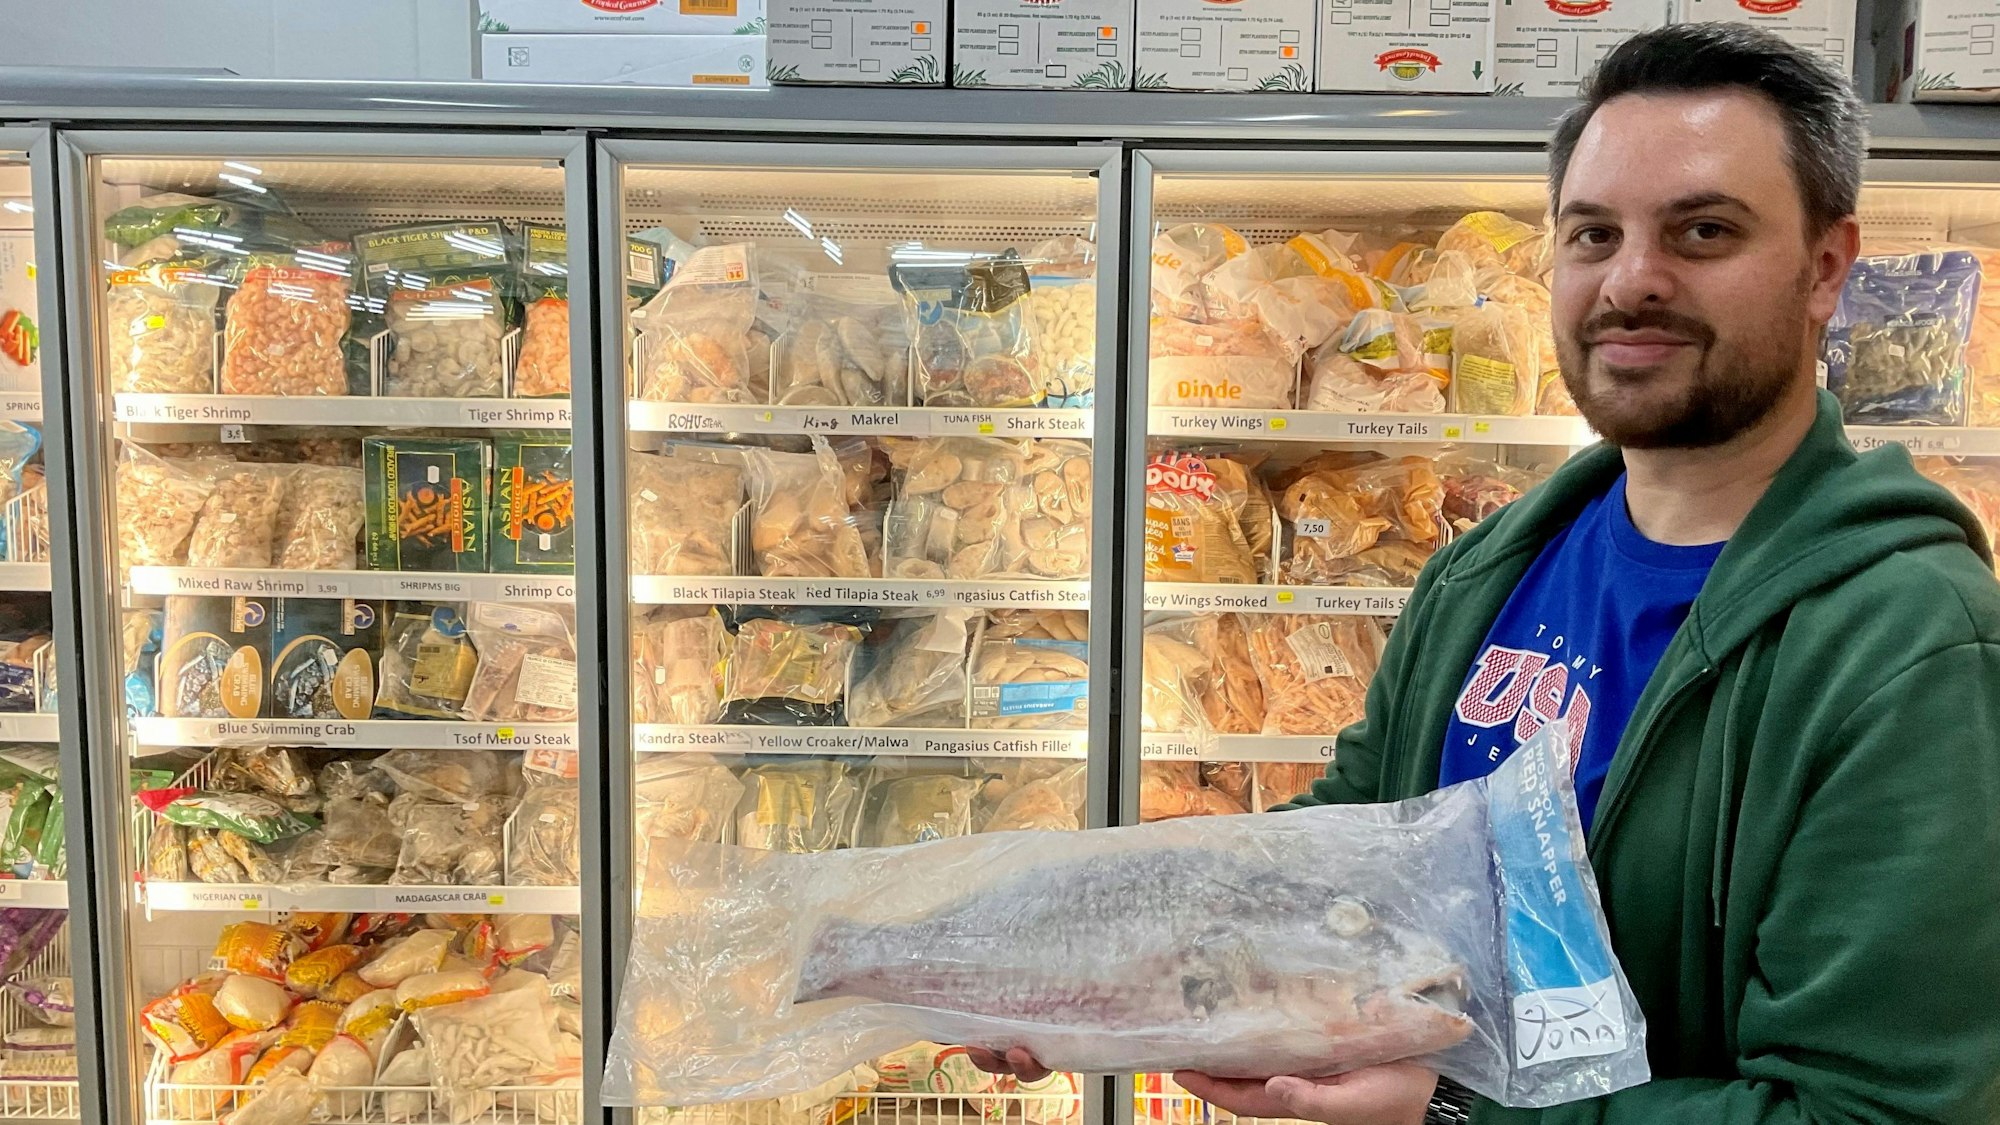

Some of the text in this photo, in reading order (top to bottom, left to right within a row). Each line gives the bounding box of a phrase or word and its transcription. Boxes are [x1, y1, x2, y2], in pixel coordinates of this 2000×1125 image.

[368, 235, 399, 248] BLACK
[401, 232, 429, 244] TIGER
[468, 227, 489, 235] P&D
[1177, 379, 1242, 399] Dinde
[6, 402, 41, 411] SPRING
[165, 406, 198, 421] Tiger
[202, 407, 251, 421] Shrimp
[468, 408, 503, 423] Tiger
[506, 409, 555, 424] Shrimp
[804, 415, 839, 430] King
[851, 413, 899, 425] Makrel
[943, 414, 992, 423] TUNA FISH
[1171, 416, 1218, 429] Turkey
[1221, 416, 1263, 430] Wings
[1007, 417, 1085, 430] Shark Steak
[1348, 423, 1428, 436] Turkey Tails
[1146, 467, 1214, 497] DOUX
[501, 468, 513, 540] ASIAN
[514, 483, 522, 525] CHOICE
[452, 492, 460, 537] CHOICE
[461, 478, 476, 553] ASIAN
[1303, 523, 1324, 534] 7,50
[178, 576, 304, 593] Mixed Raw Shrimp
[400, 581, 461, 592] SHRIPMS BIG
[504, 585, 575, 599] Shrimp Co
[673, 587, 796, 601] Black Tilapia Steak
[834, 588, 878, 602] Tilapia
[882, 590, 919, 602] Steak
[926, 588, 945, 598] 6,99
[953, 591, 1005, 603] ngasius
[1008, 590, 1054, 602] Catfish
[1170, 594, 1211, 608] Wings
[1214, 595, 1267, 608] Smoked
[1315, 597, 1361, 611] Turkey
[1364, 597, 1395, 609] Tails
[218, 722, 356, 738] Blue Swimming Crab
[453, 732, 571, 745] Tsof Merou Steak
[638, 733, 725, 744] Kandra Steak
[759, 734, 909, 748] Yellow Croaker/Malwa
[925, 740, 989, 755] Pangasius
[993, 740, 1039, 752] Catfish
[1166, 744, 1198, 756] Fillet
[1520, 748, 1567, 907] RED SNAPPER
[193, 893, 263, 901] NIGERIAN CRAB
[395, 892, 487, 903] MADAGASCAR CRAB
